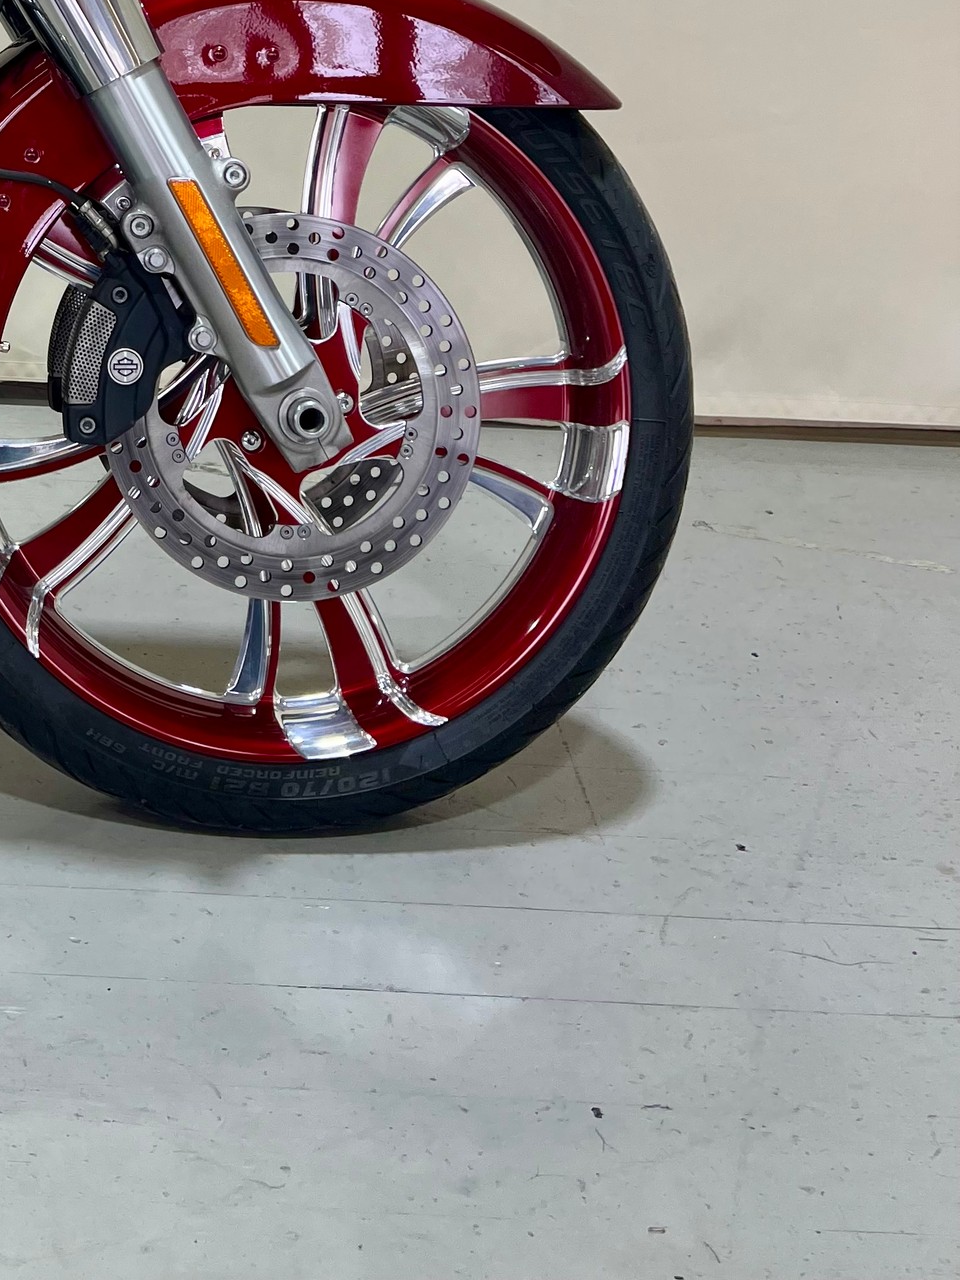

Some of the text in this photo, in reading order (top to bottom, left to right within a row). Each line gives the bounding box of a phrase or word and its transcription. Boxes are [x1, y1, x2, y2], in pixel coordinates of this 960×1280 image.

[138, 742, 341, 779] REINFORCED FRONT
[280, 767, 390, 797] 120/70
